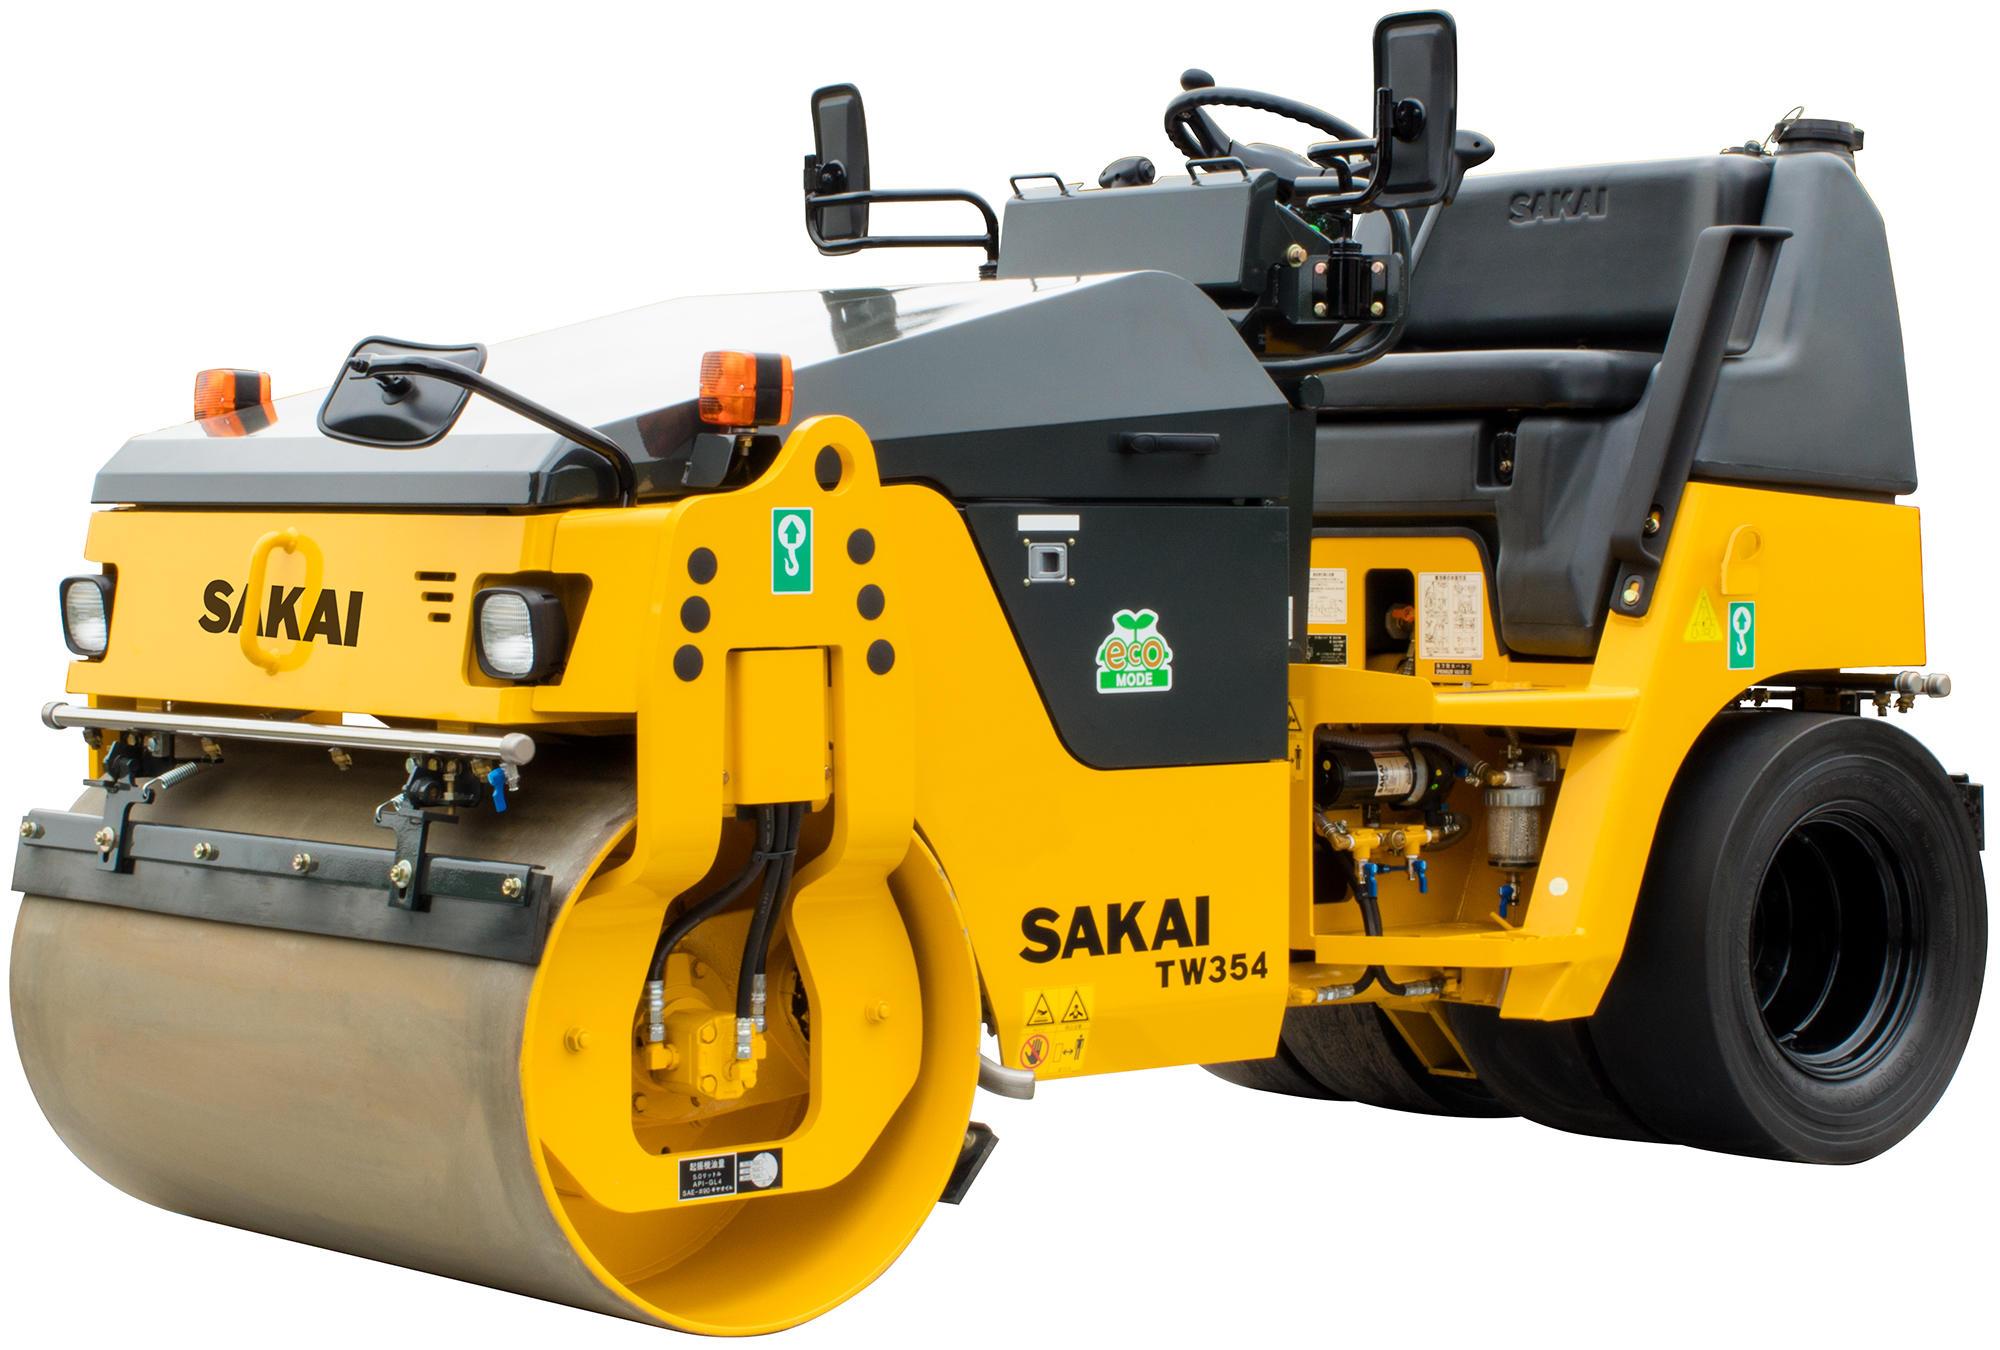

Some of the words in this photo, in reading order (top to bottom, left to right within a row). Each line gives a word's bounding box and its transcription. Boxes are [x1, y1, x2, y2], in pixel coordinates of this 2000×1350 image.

[1508, 187, 1608, 225] SAKAI
[1105, 640, 1164, 670] eco
[1116, 672, 1153, 687] MODE
[1019, 895, 1210, 964] SAKAI
[1156, 951, 1268, 988] TW354
